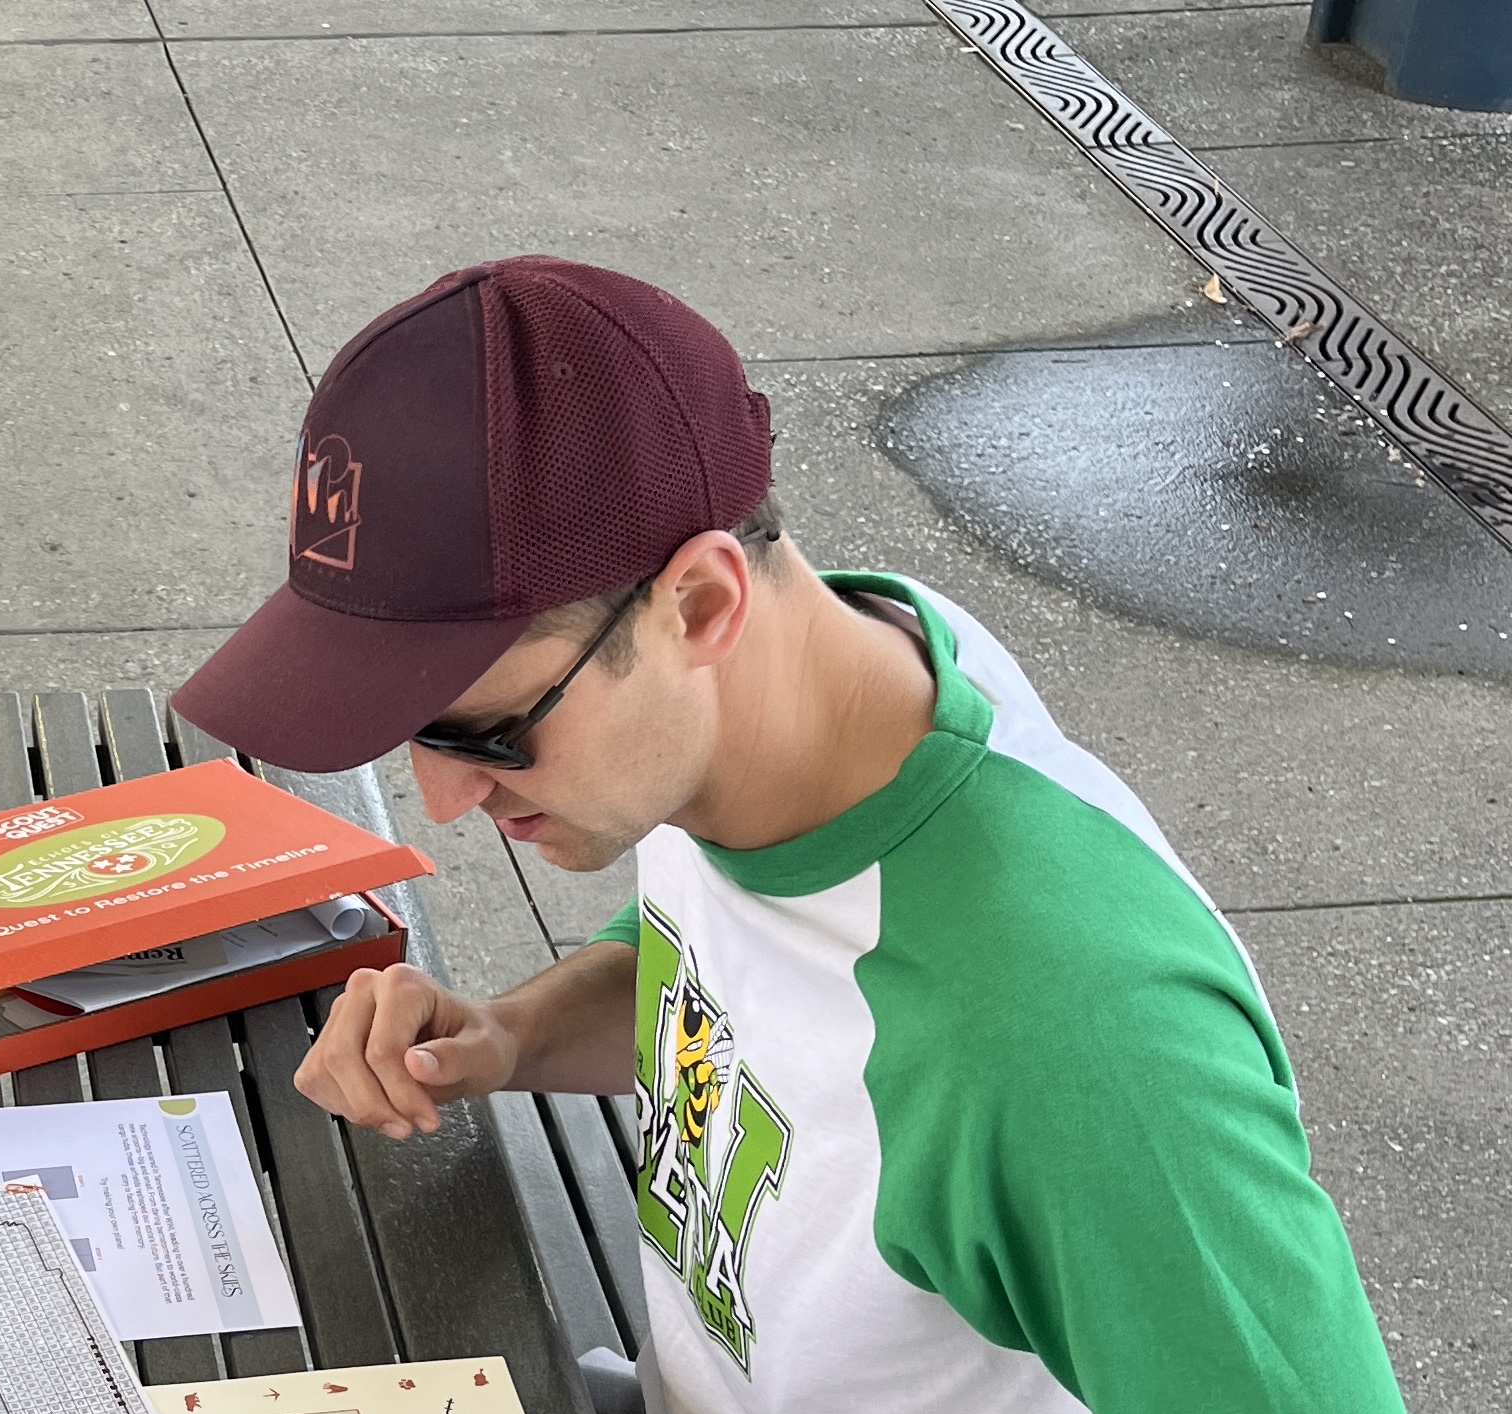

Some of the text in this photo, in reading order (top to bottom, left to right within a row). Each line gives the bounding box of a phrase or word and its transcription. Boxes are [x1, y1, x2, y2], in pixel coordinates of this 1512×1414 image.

[6, 812, 77, 839] QUEST
[27, 840, 93, 866] ECHOES
[64, 905, 91, 917] to
[94, 881, 187, 910] Restore
[189, 870, 230, 884] the
[230, 844, 329, 873] Timeline
[176, 1125, 242, 1297] SCATTERED ACROSS THE SKIES
